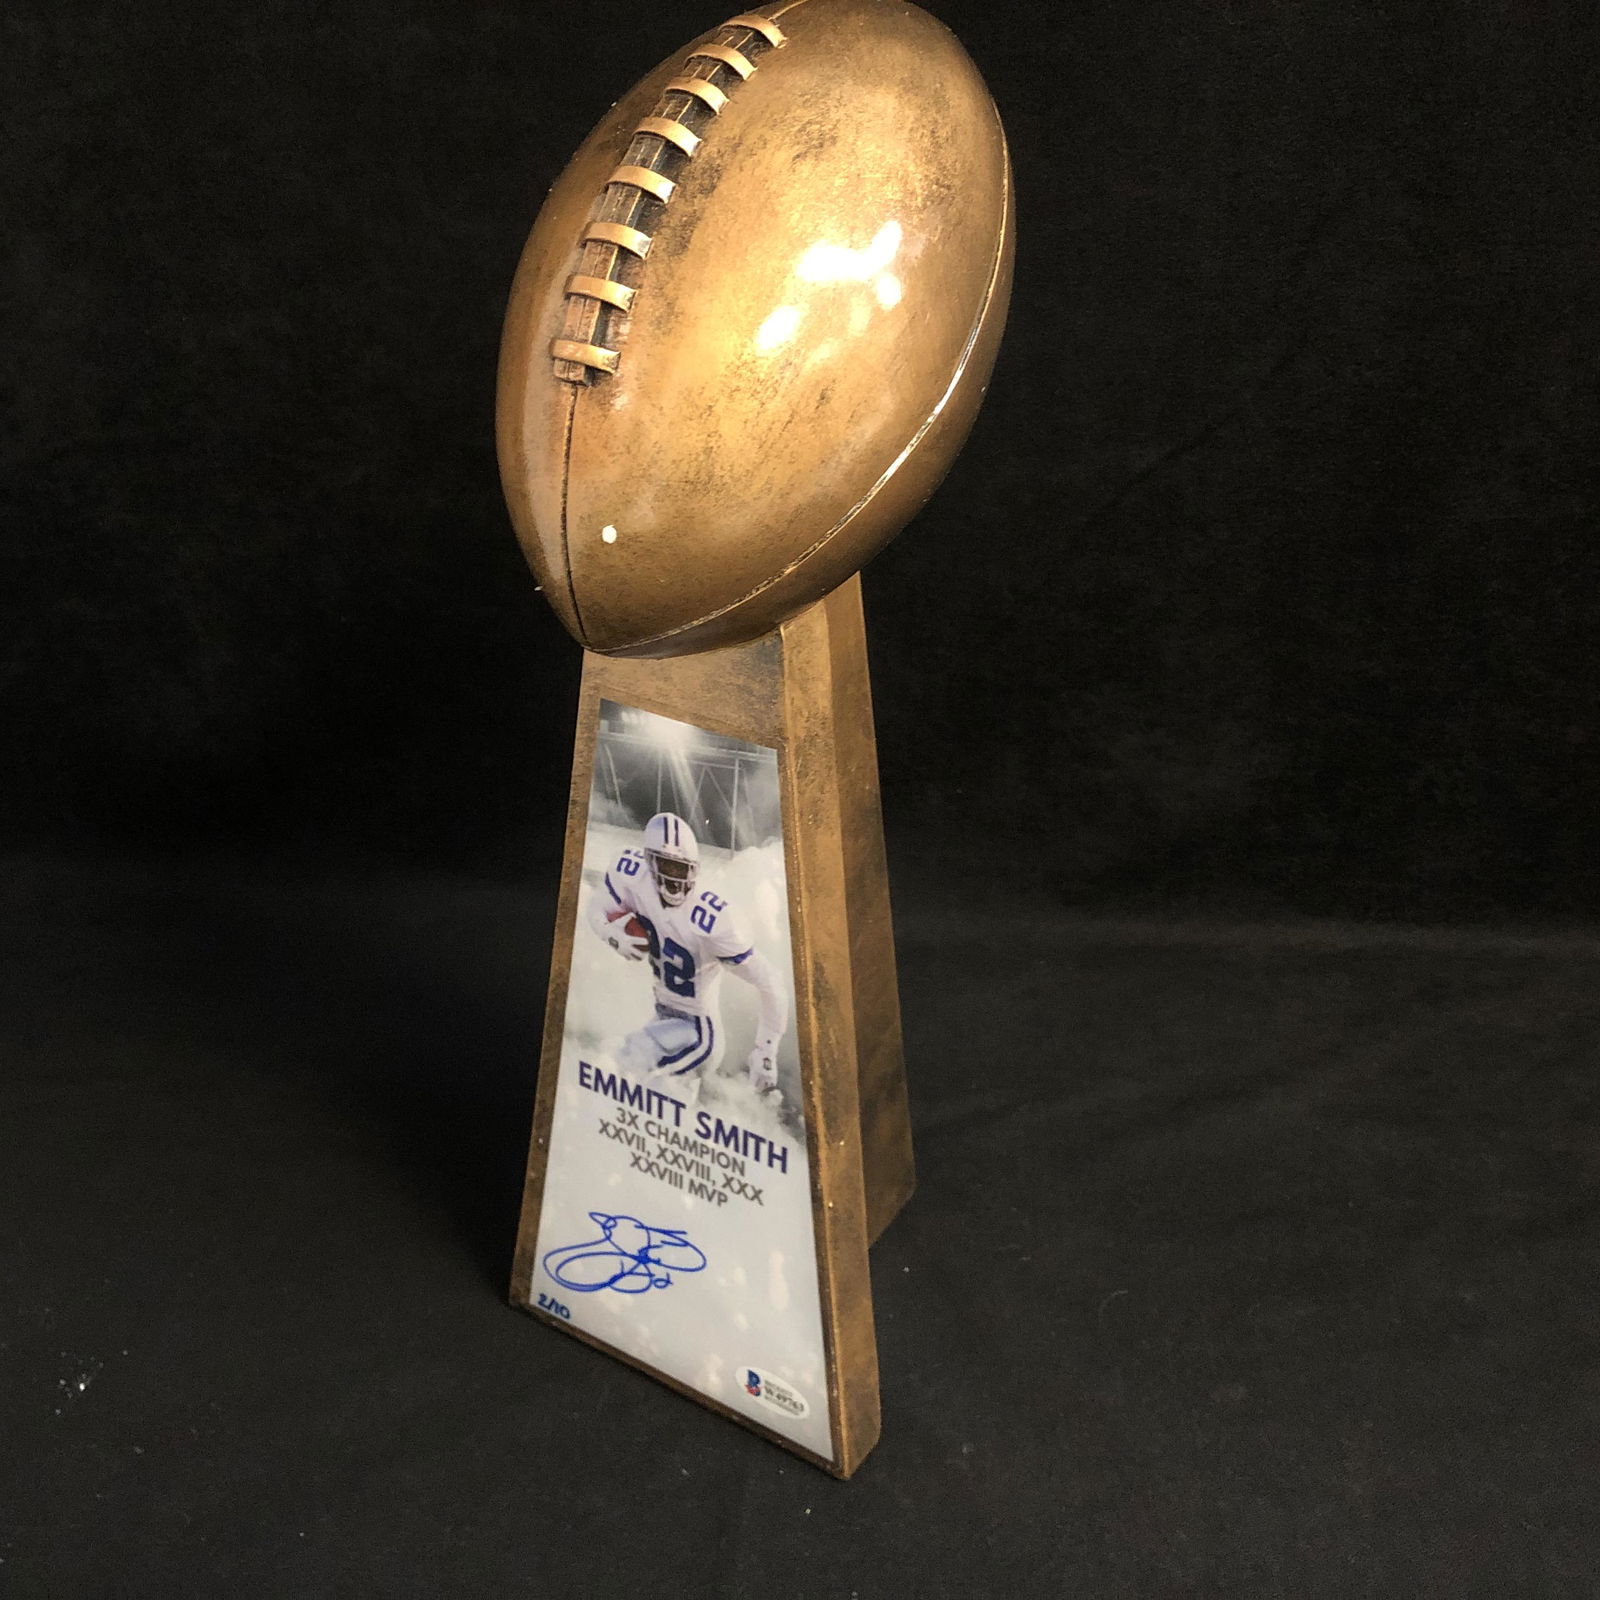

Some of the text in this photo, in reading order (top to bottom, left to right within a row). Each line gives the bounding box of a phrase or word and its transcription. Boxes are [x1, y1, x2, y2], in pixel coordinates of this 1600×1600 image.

[690, 891, 728, 934] 22
[579, 1060, 788, 1174] EMMITT SMITH
[616, 1107, 746, 1177] 3X CHAMPION
[598, 1118, 764, 1206] XXVII, XXVIII, XXX
[629, 1152, 729, 1207] XXVIII MVP
